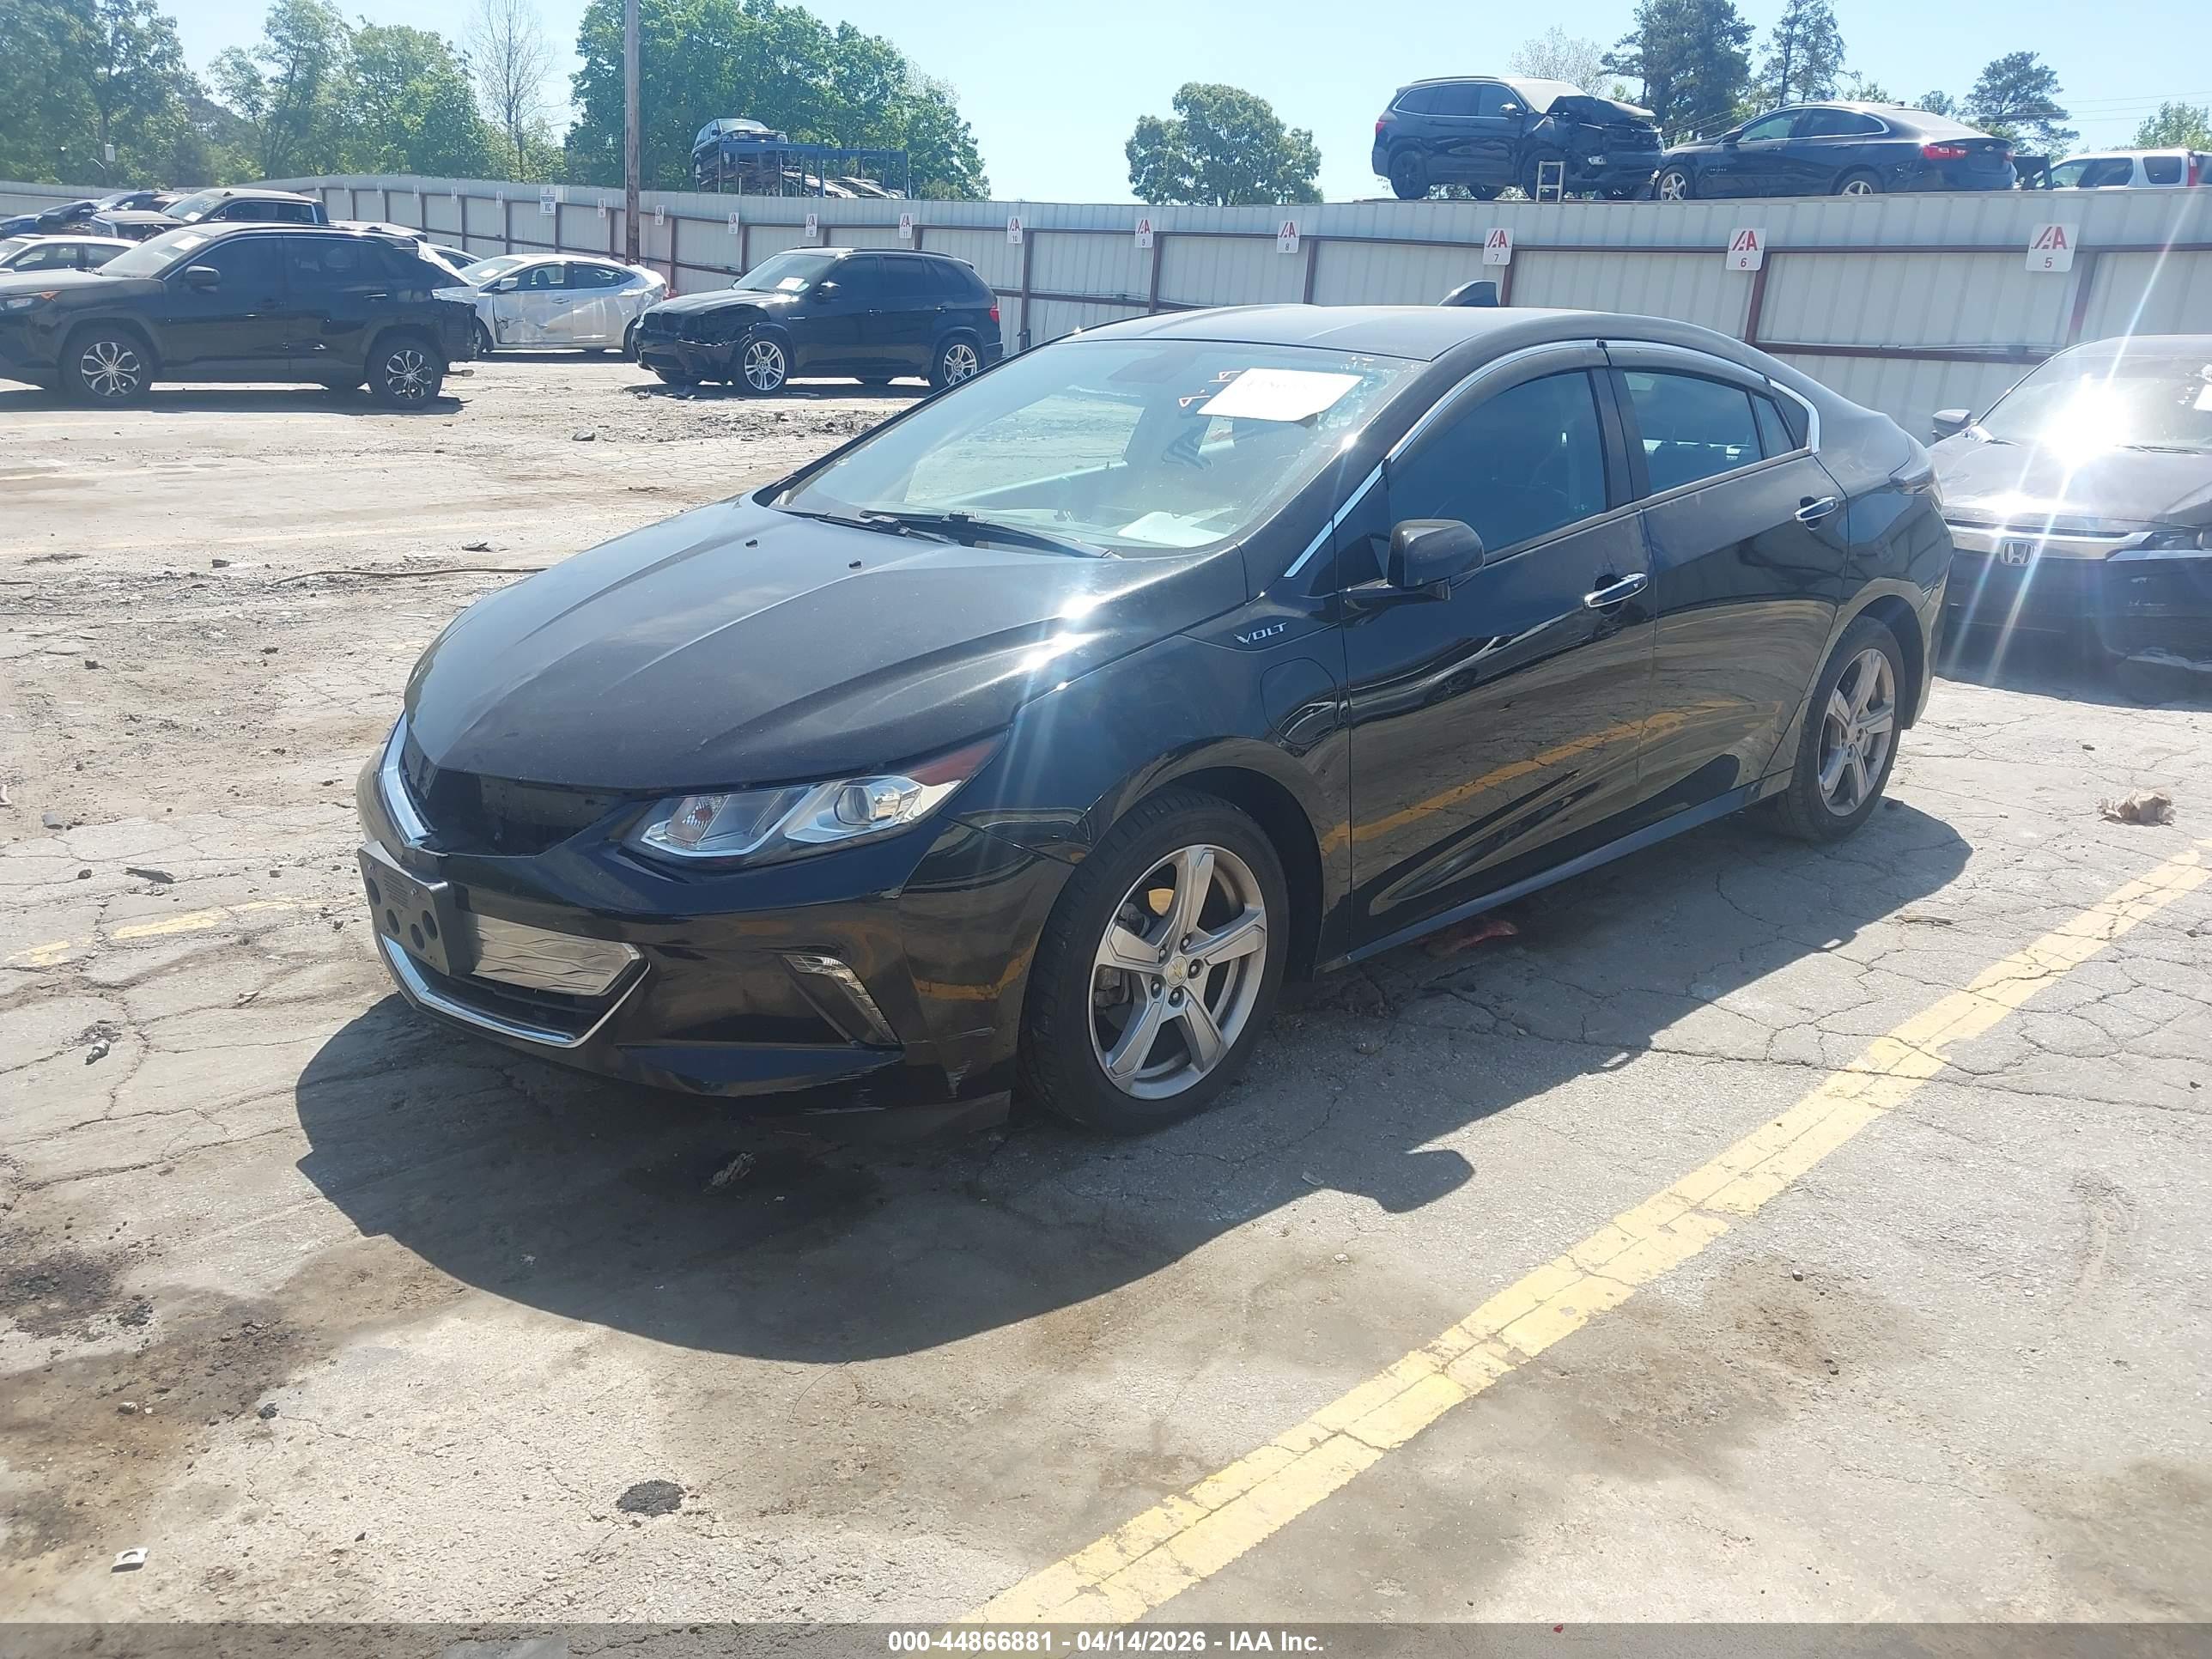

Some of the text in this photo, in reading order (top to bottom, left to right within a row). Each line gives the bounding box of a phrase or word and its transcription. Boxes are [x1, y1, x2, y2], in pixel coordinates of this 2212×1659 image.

[1493, 253, 1499, 263] 7
[1741, 257, 1748, 268] 6
[2045, 257, 2053, 269] 5
[1234, 622, 1287, 645] VOLT
